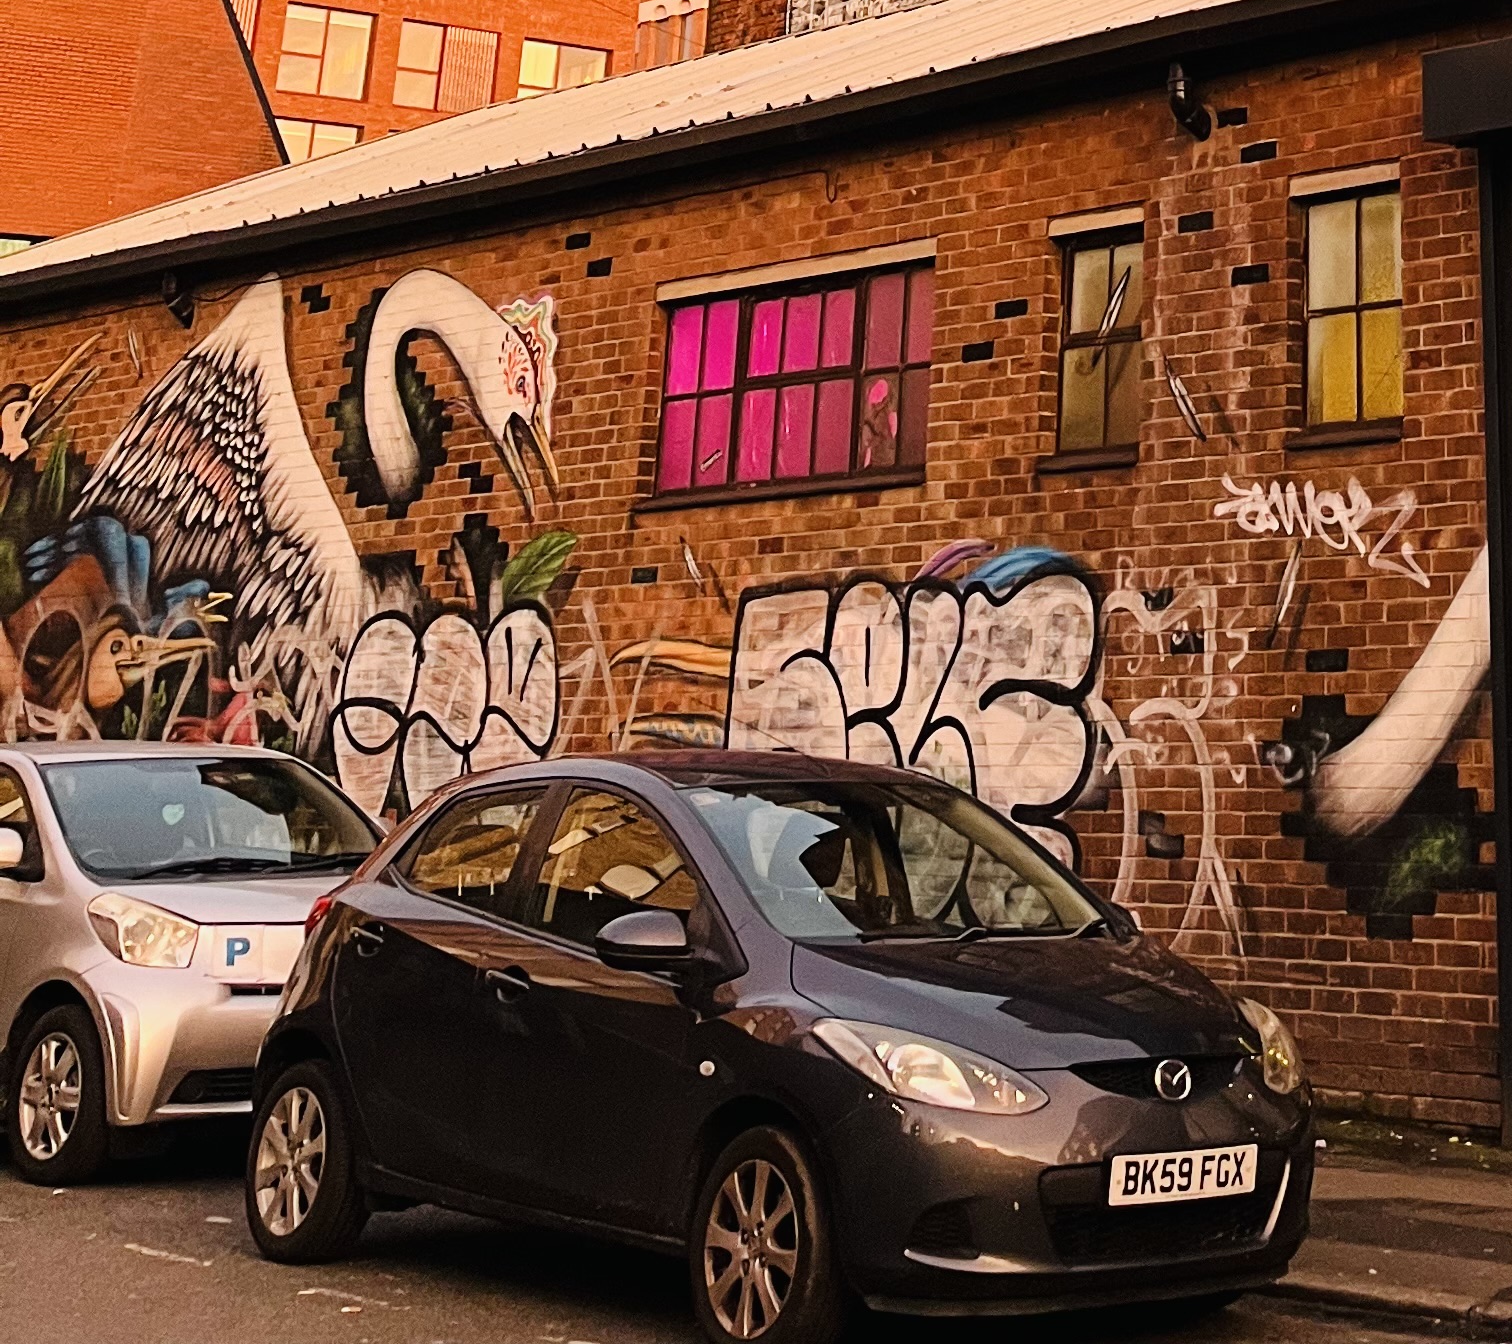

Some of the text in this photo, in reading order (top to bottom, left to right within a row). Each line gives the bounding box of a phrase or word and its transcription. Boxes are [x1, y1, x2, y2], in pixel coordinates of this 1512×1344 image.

[226, 937, 250, 966] P
[1122, 1151, 1246, 1196] BK59 FGX
